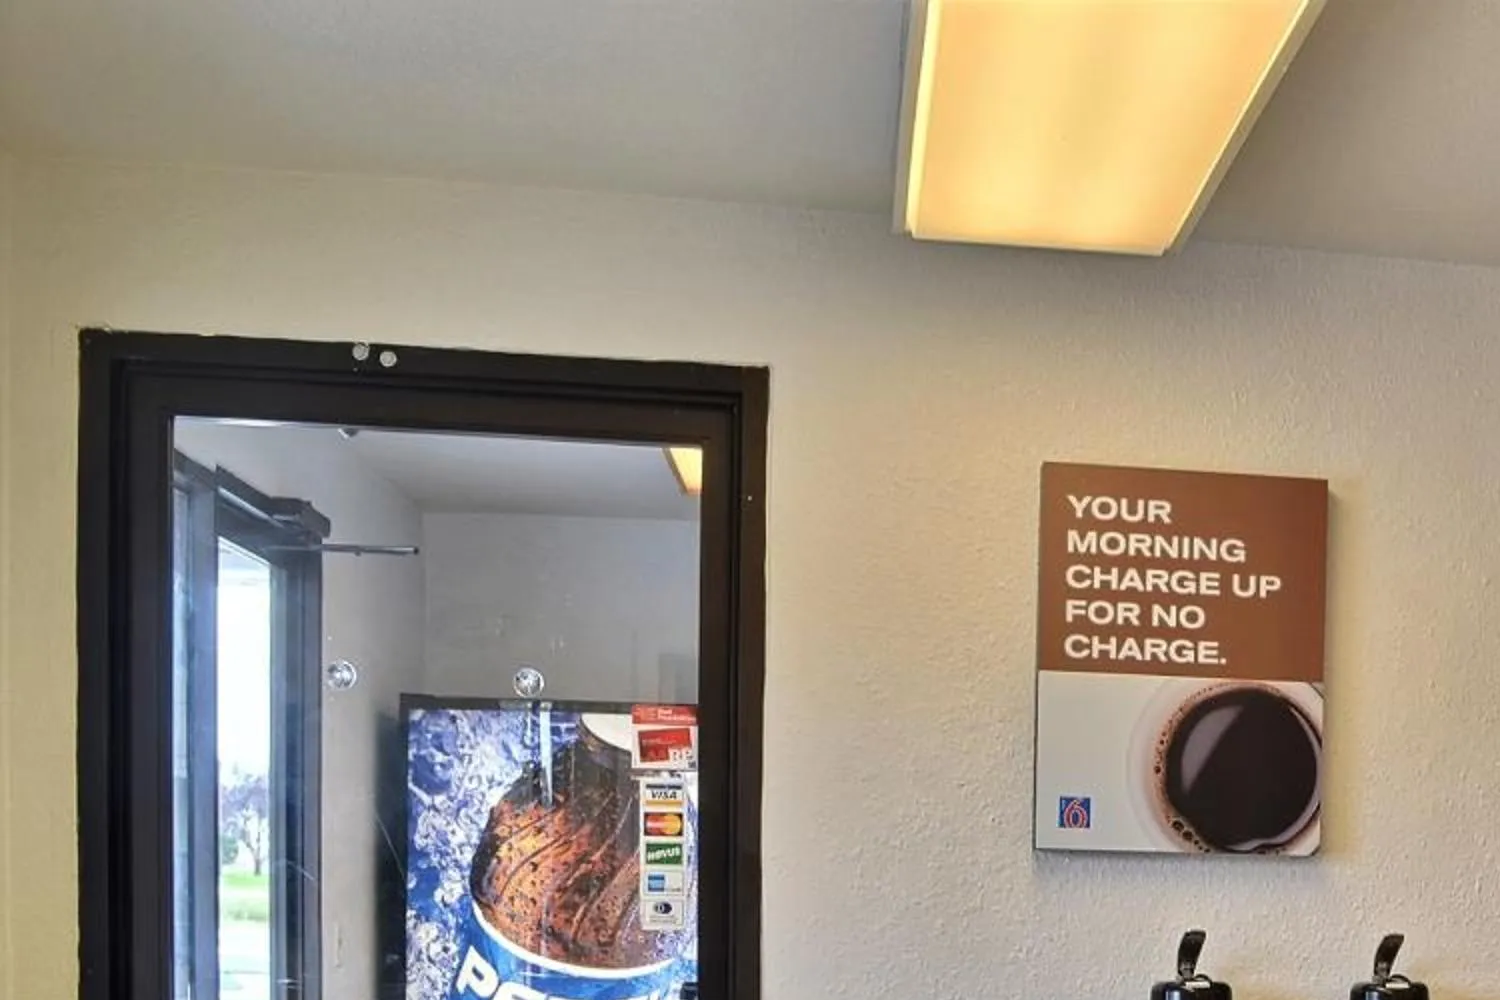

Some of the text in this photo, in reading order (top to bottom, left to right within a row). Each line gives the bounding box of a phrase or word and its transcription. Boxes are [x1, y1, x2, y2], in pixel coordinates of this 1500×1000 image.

[1067, 495, 1172, 524] YOUR
[1066, 530, 1247, 563] MORNING
[1065, 564, 1282, 599] CHARGE UP
[1065, 600, 1206, 630] FOR NO
[1064, 634, 1228, 665] CHARGE.
[651, 791, 677, 800] VISA
